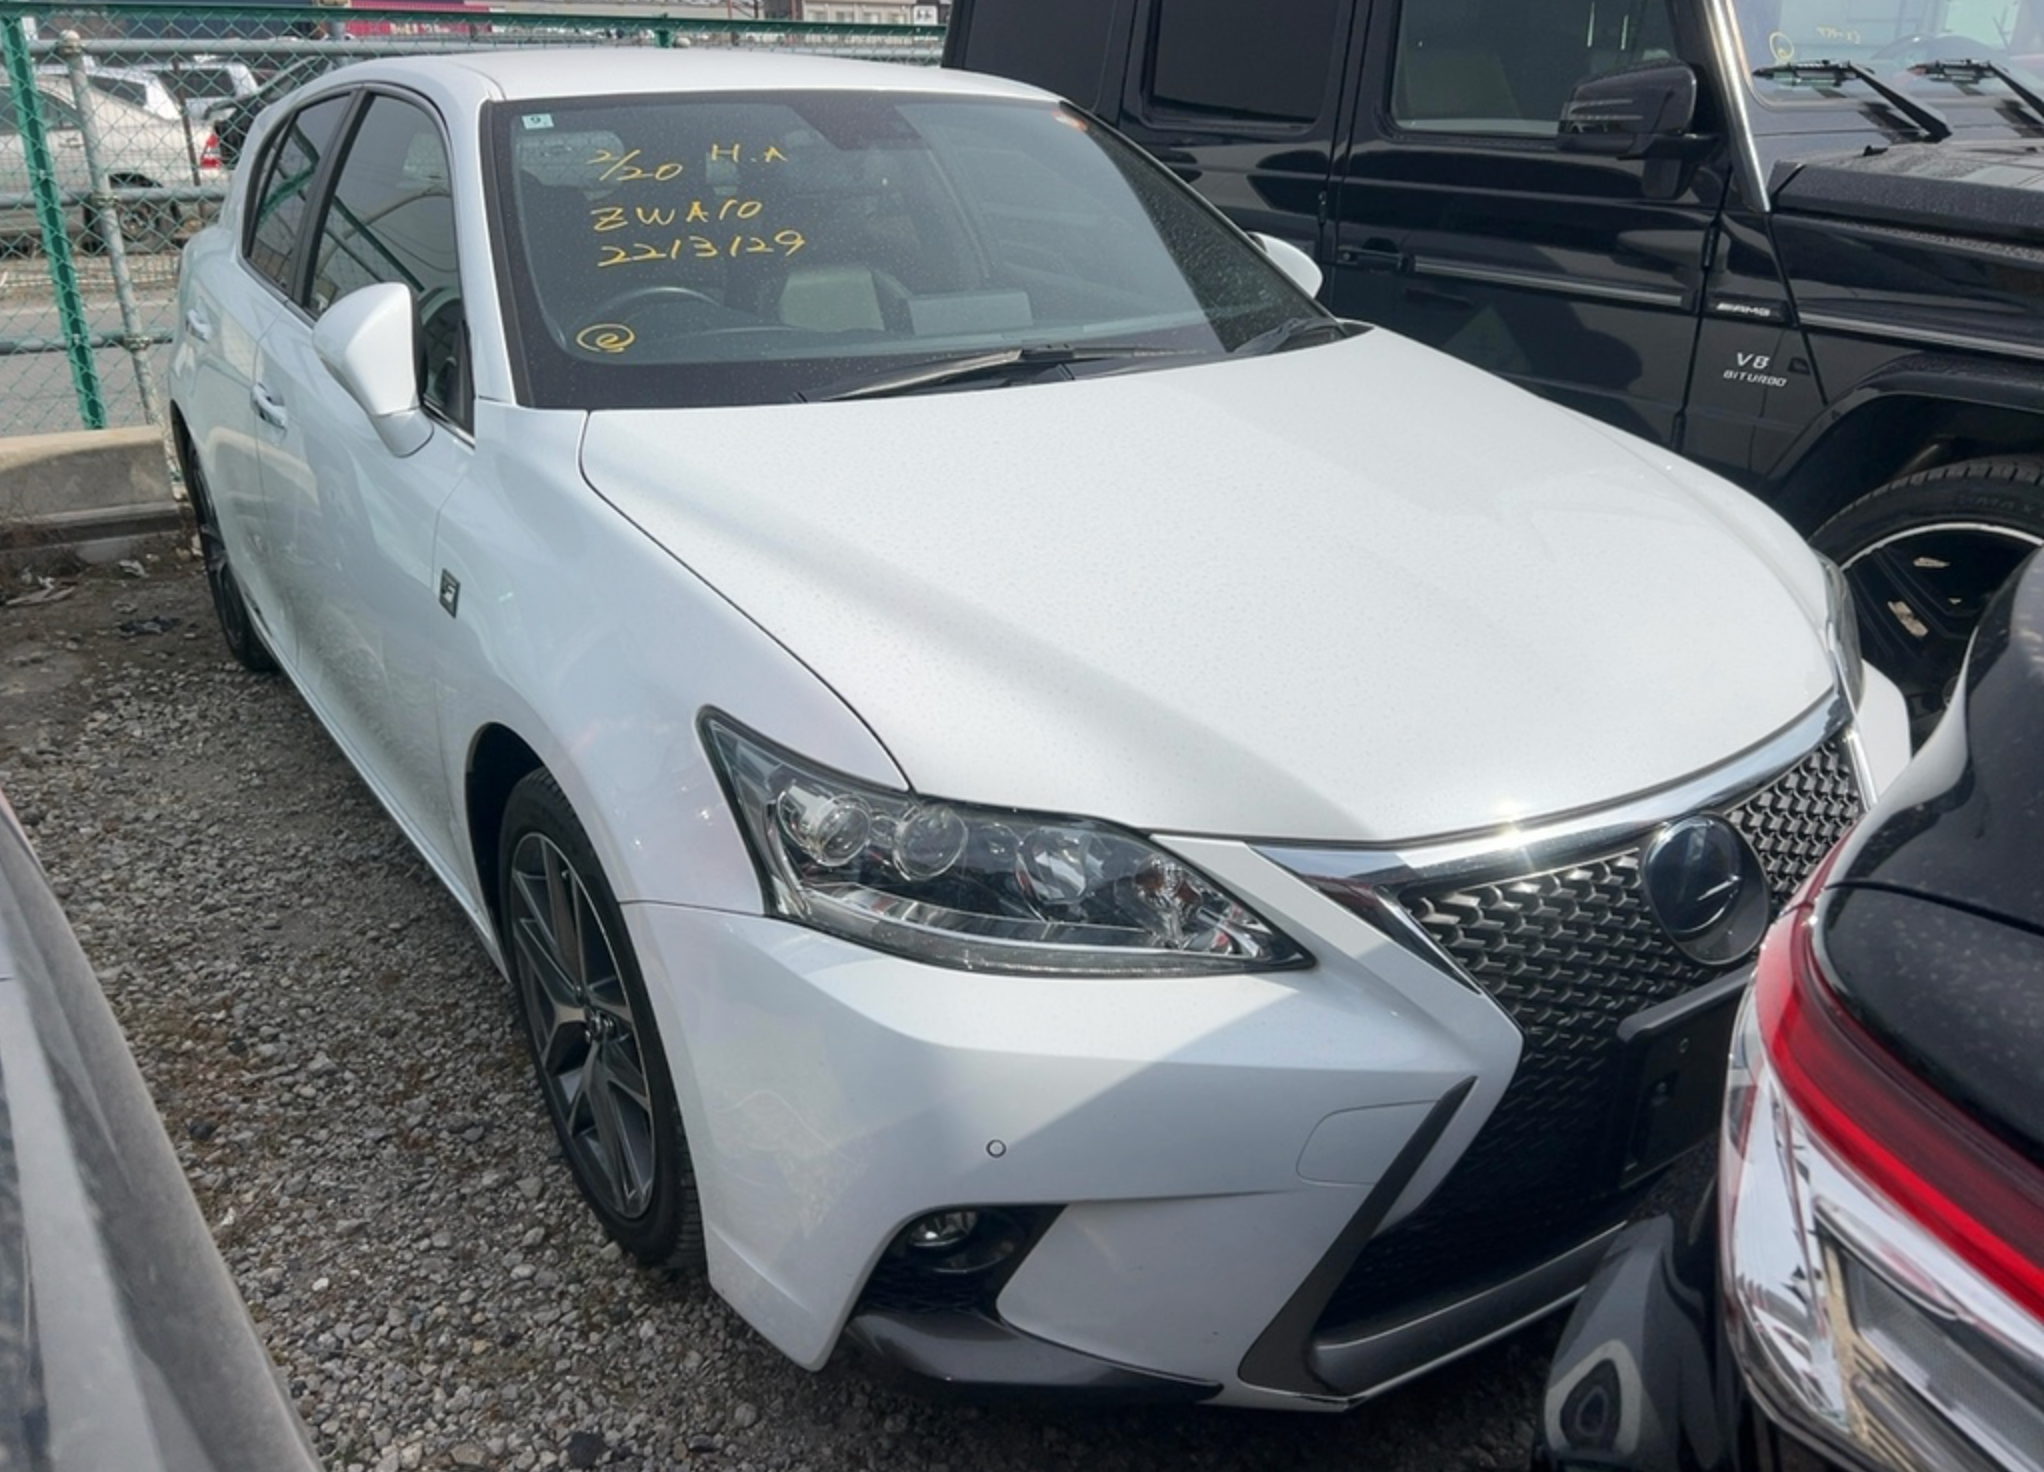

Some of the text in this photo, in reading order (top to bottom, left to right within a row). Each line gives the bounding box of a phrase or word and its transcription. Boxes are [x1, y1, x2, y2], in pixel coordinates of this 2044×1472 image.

[597, 229, 805, 267] 2213129
[1737, 352, 1770, 369] V8
[1723, 369, 1787, 387] BITURBO
